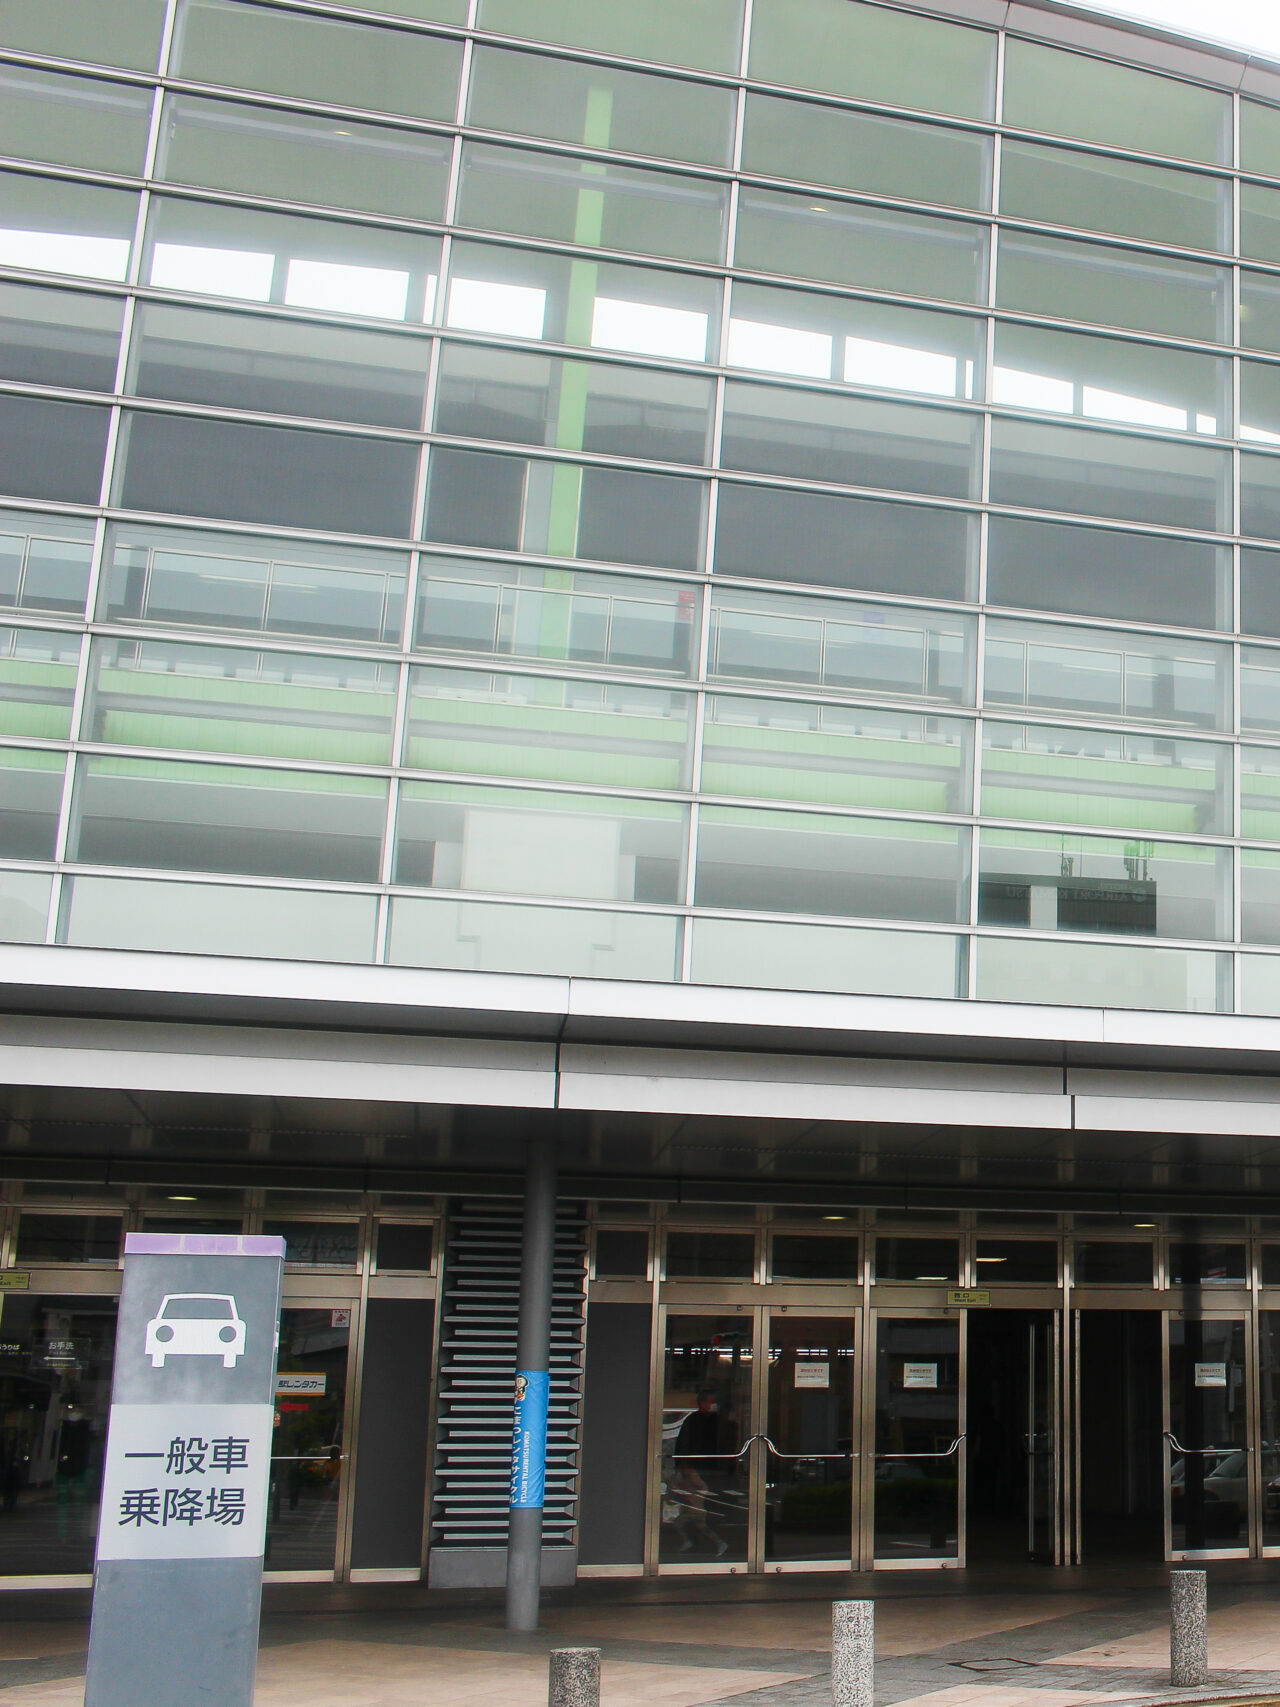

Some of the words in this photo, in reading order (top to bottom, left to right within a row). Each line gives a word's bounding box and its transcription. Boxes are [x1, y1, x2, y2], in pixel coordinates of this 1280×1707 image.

[124, 1436, 250, 1475] 一般車
[509, 1406, 522, 1504] こまつレンタサイクル
[118, 1487, 247, 1527] 乗降場
